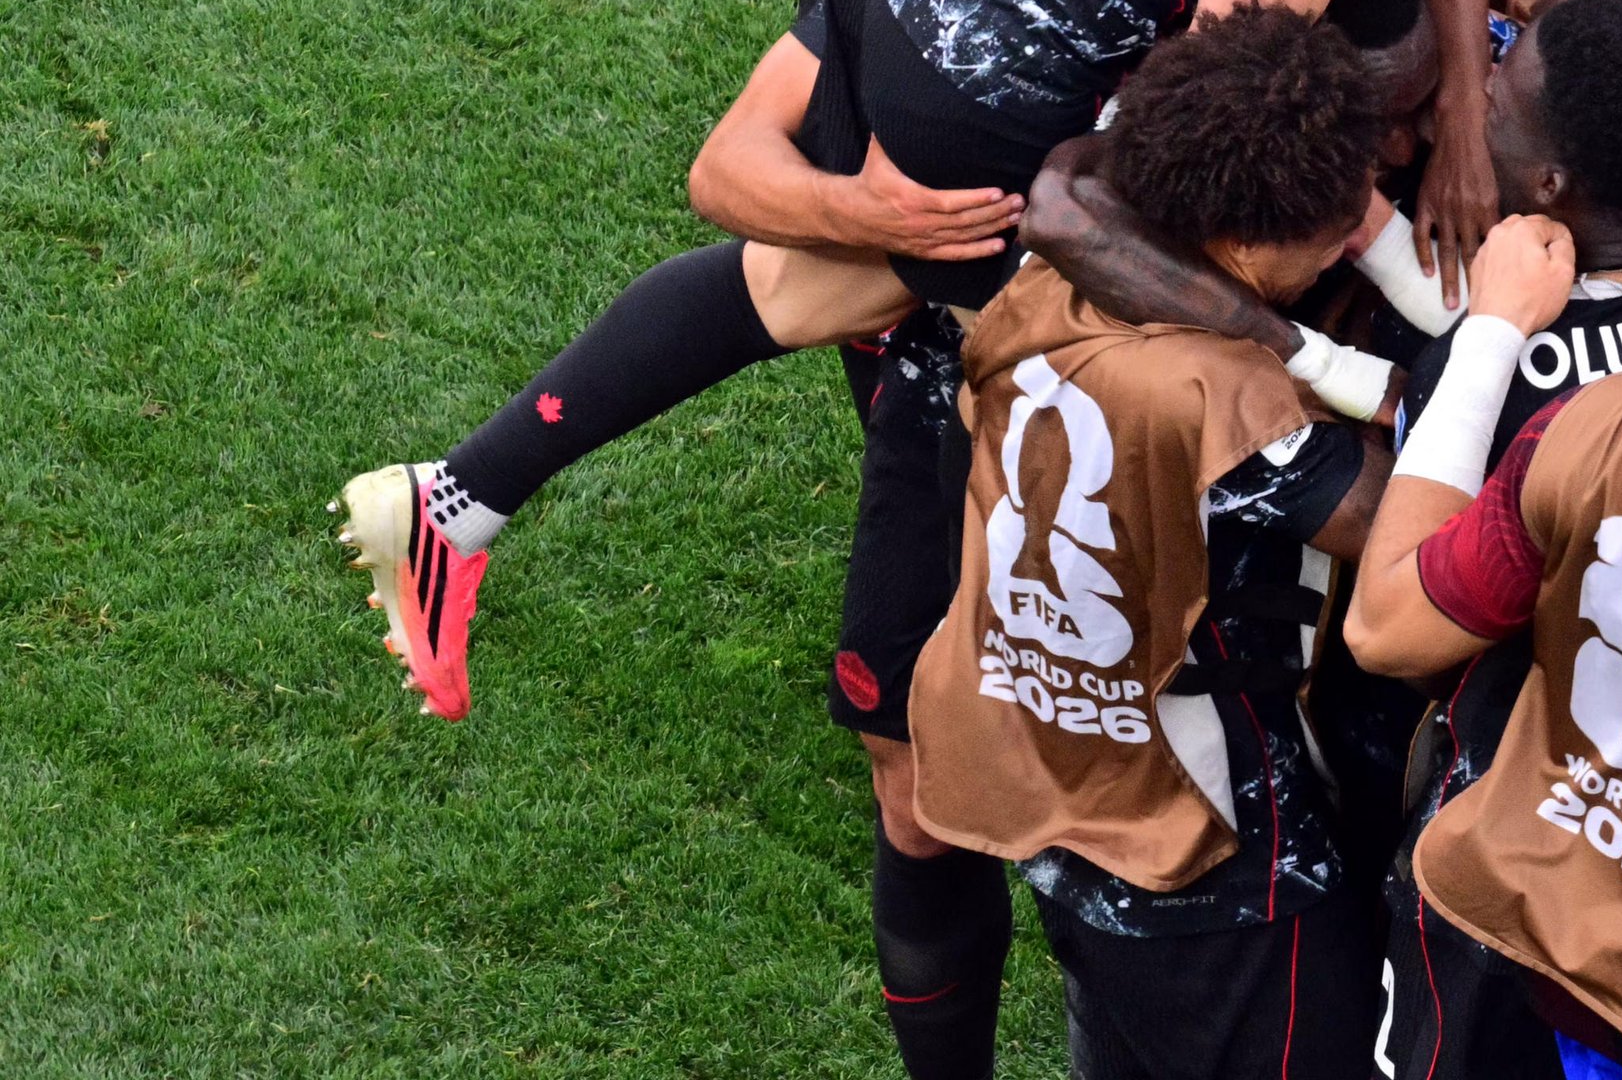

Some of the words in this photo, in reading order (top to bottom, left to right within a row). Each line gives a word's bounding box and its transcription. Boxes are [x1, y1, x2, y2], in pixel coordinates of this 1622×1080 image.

[1009, 591, 1084, 640] FIFA
[978, 655, 1151, 744] 2026
[984, 629, 1073, 689] WORLD
[1079, 672, 1144, 701] CUP
